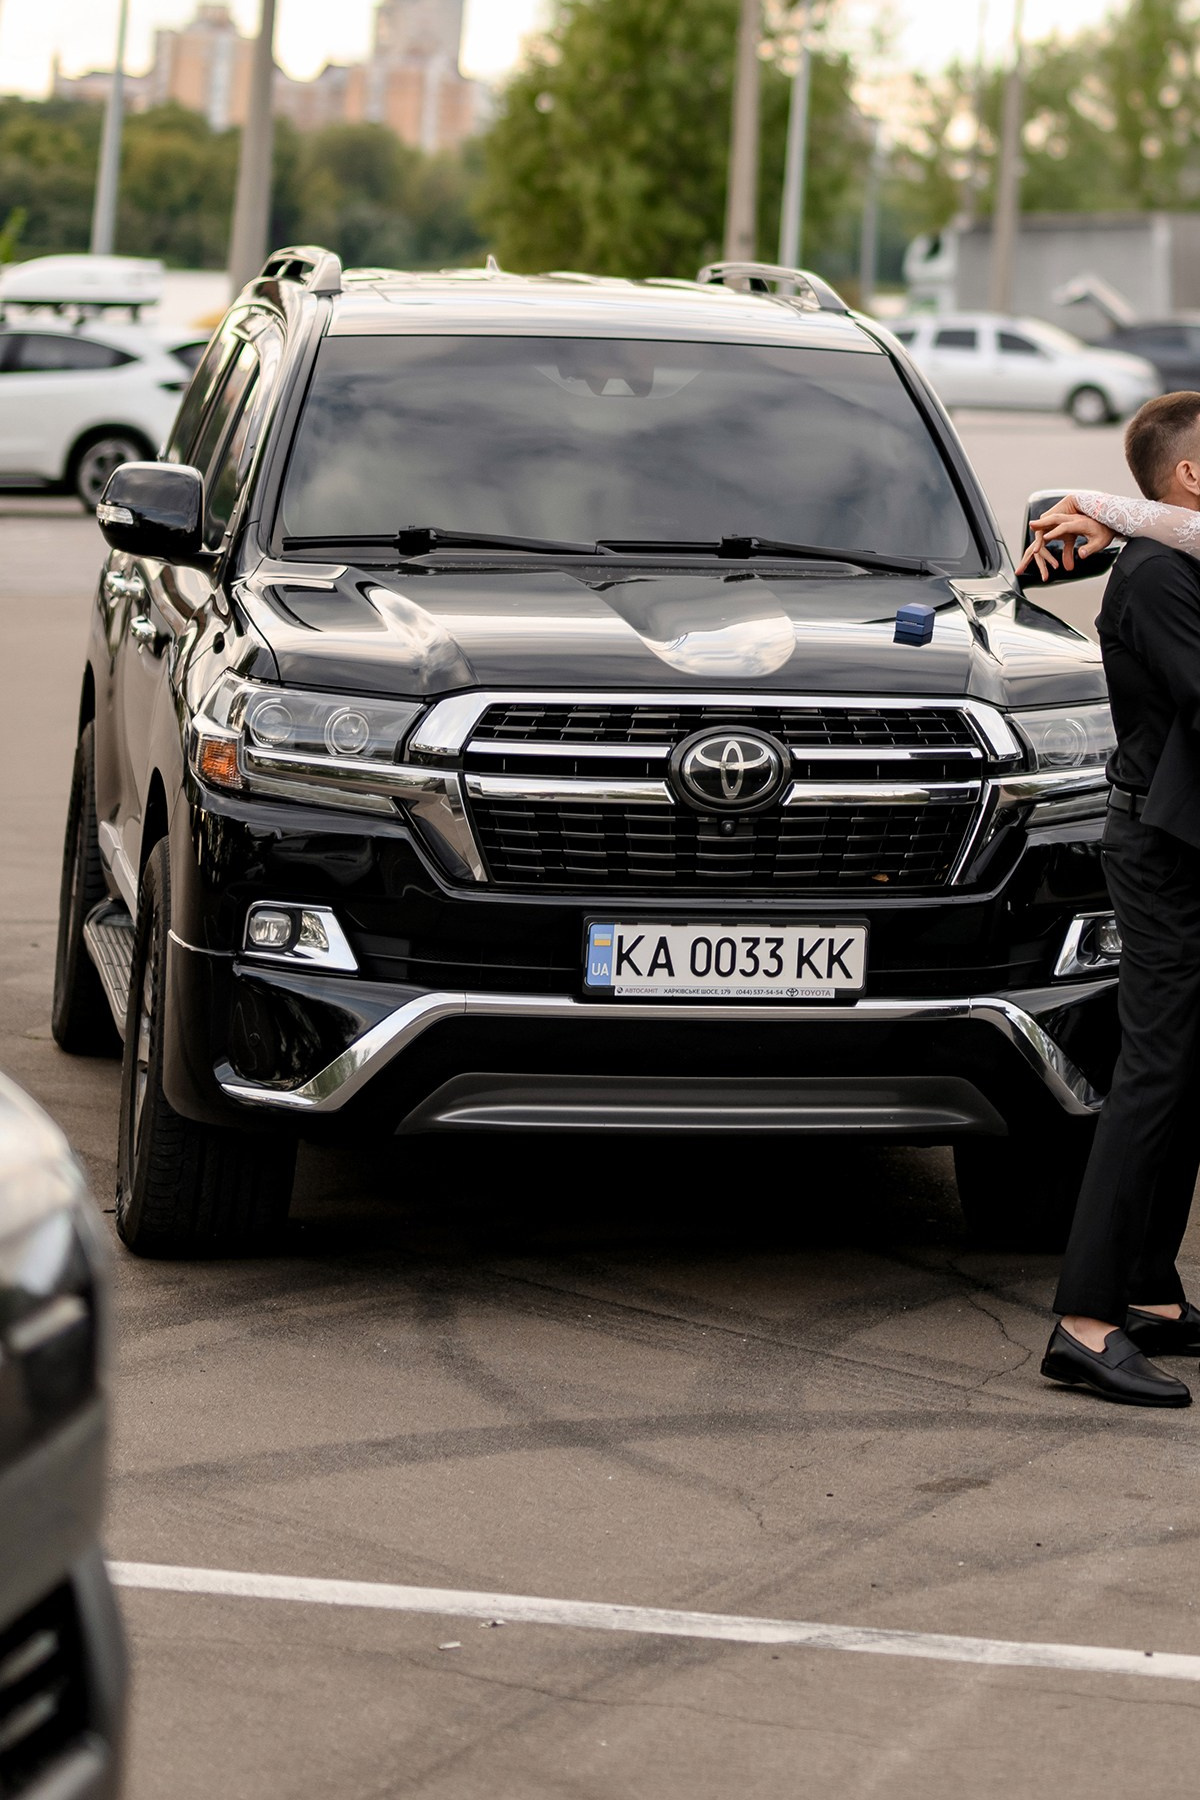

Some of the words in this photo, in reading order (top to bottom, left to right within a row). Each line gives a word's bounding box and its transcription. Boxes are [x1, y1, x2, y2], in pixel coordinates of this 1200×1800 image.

[615, 935, 675, 977] KA
[690, 936, 784, 978] 0033
[796, 938, 855, 979] KK
[591, 962, 609, 976] UA
[735, 988, 753, 996] (044)
[800, 989, 831, 997] TOYOTA
